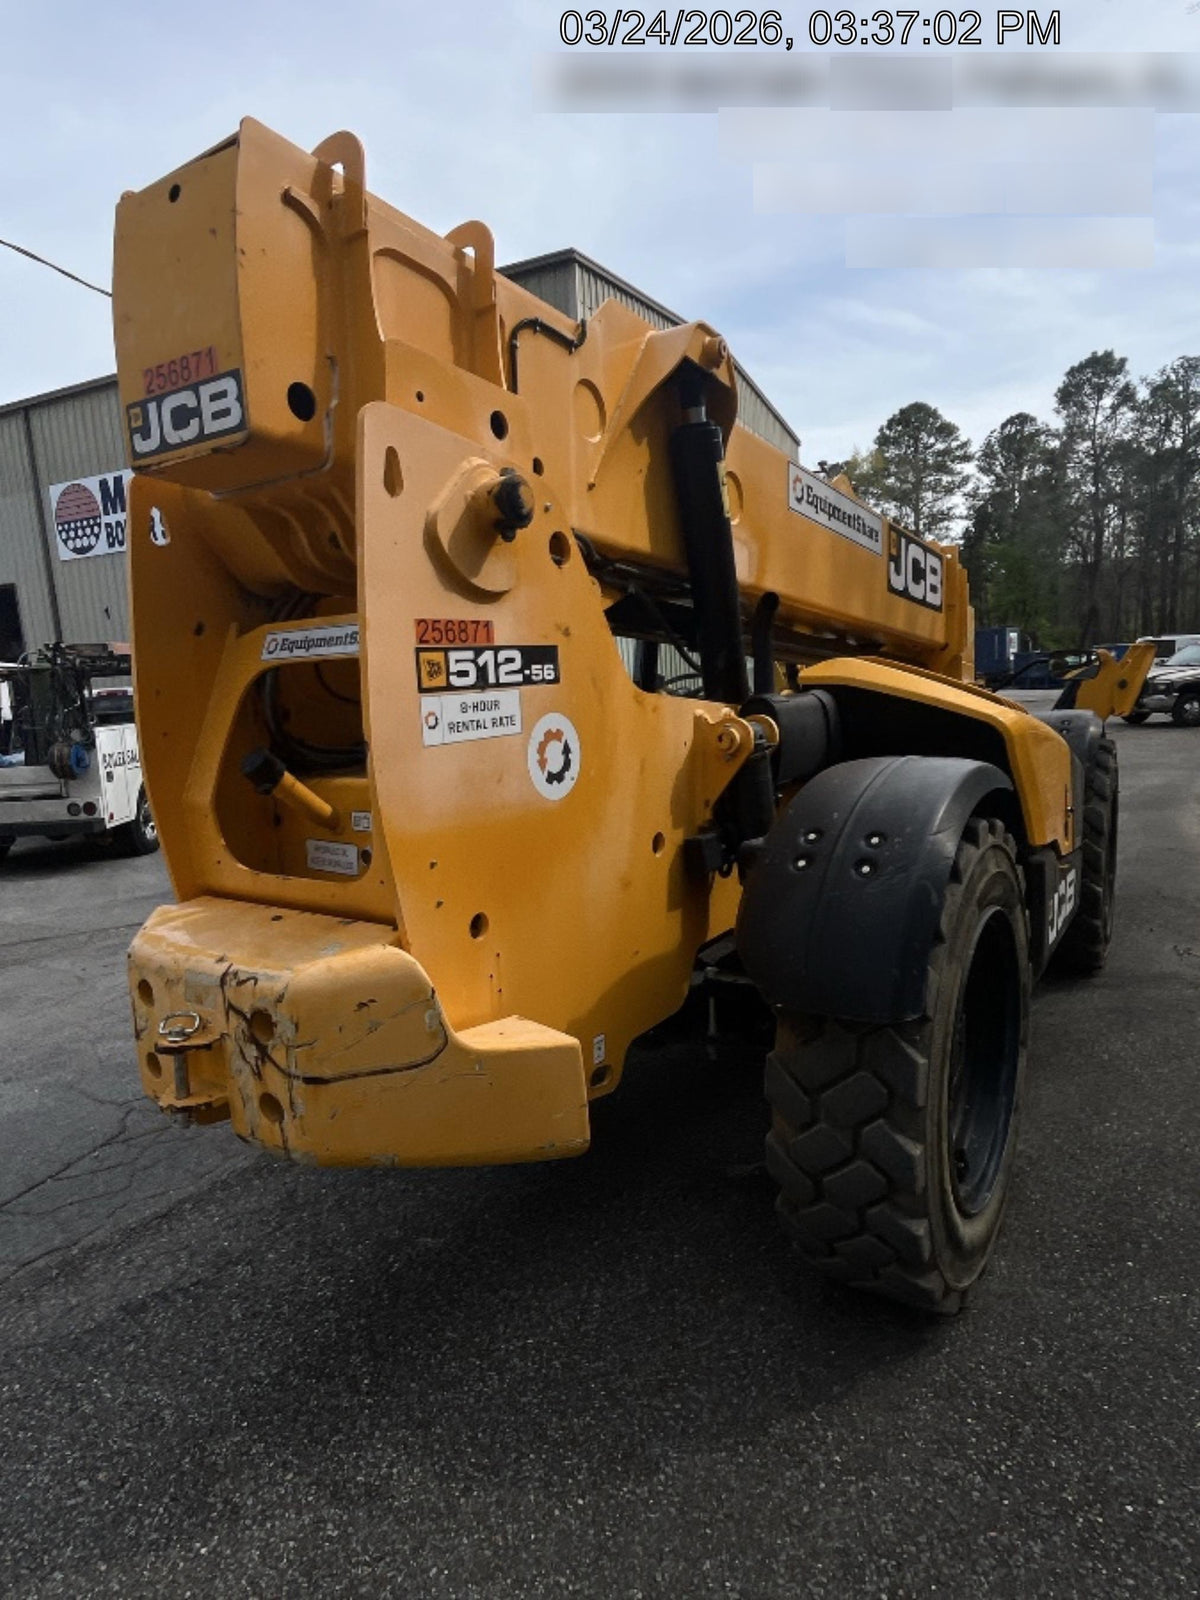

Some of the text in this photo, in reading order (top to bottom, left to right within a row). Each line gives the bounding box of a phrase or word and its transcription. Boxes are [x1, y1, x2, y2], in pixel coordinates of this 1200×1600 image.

[144, 346, 215, 394] 256871
[132, 376, 243, 454] JCB
[805, 483, 879, 543] EquipmentShare
[889, 537, 942, 607] JCB
[279, 630, 360, 653] EquipmentS
[416, 619, 492, 644] 256871
[447, 649, 556, 687] 512-56
[447, 714, 517, 735] RENTAL RATE
[459, 699, 501, 714] 8-HOUR
[1048, 868, 1077, 945] JCB
